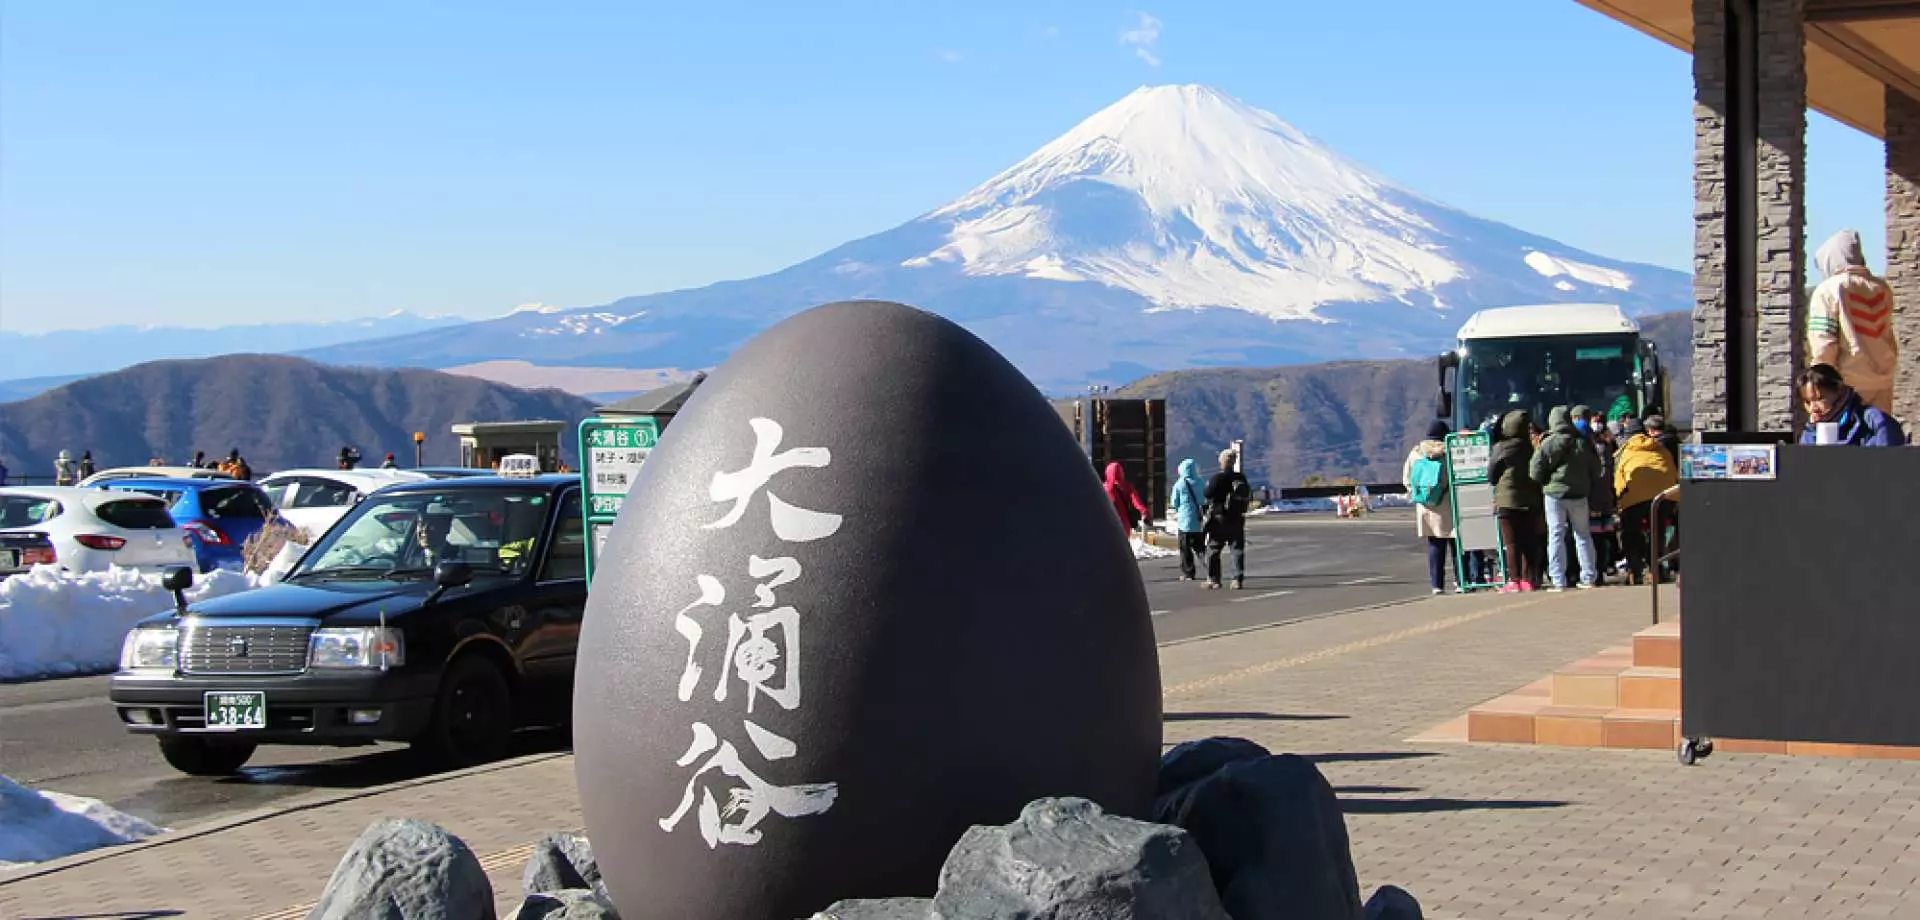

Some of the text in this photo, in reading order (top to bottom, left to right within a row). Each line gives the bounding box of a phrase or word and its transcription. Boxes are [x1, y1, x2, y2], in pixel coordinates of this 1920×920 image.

[590, 429, 629, 446] 大涌谷
[657, 416, 843, 849] 大涌谷
